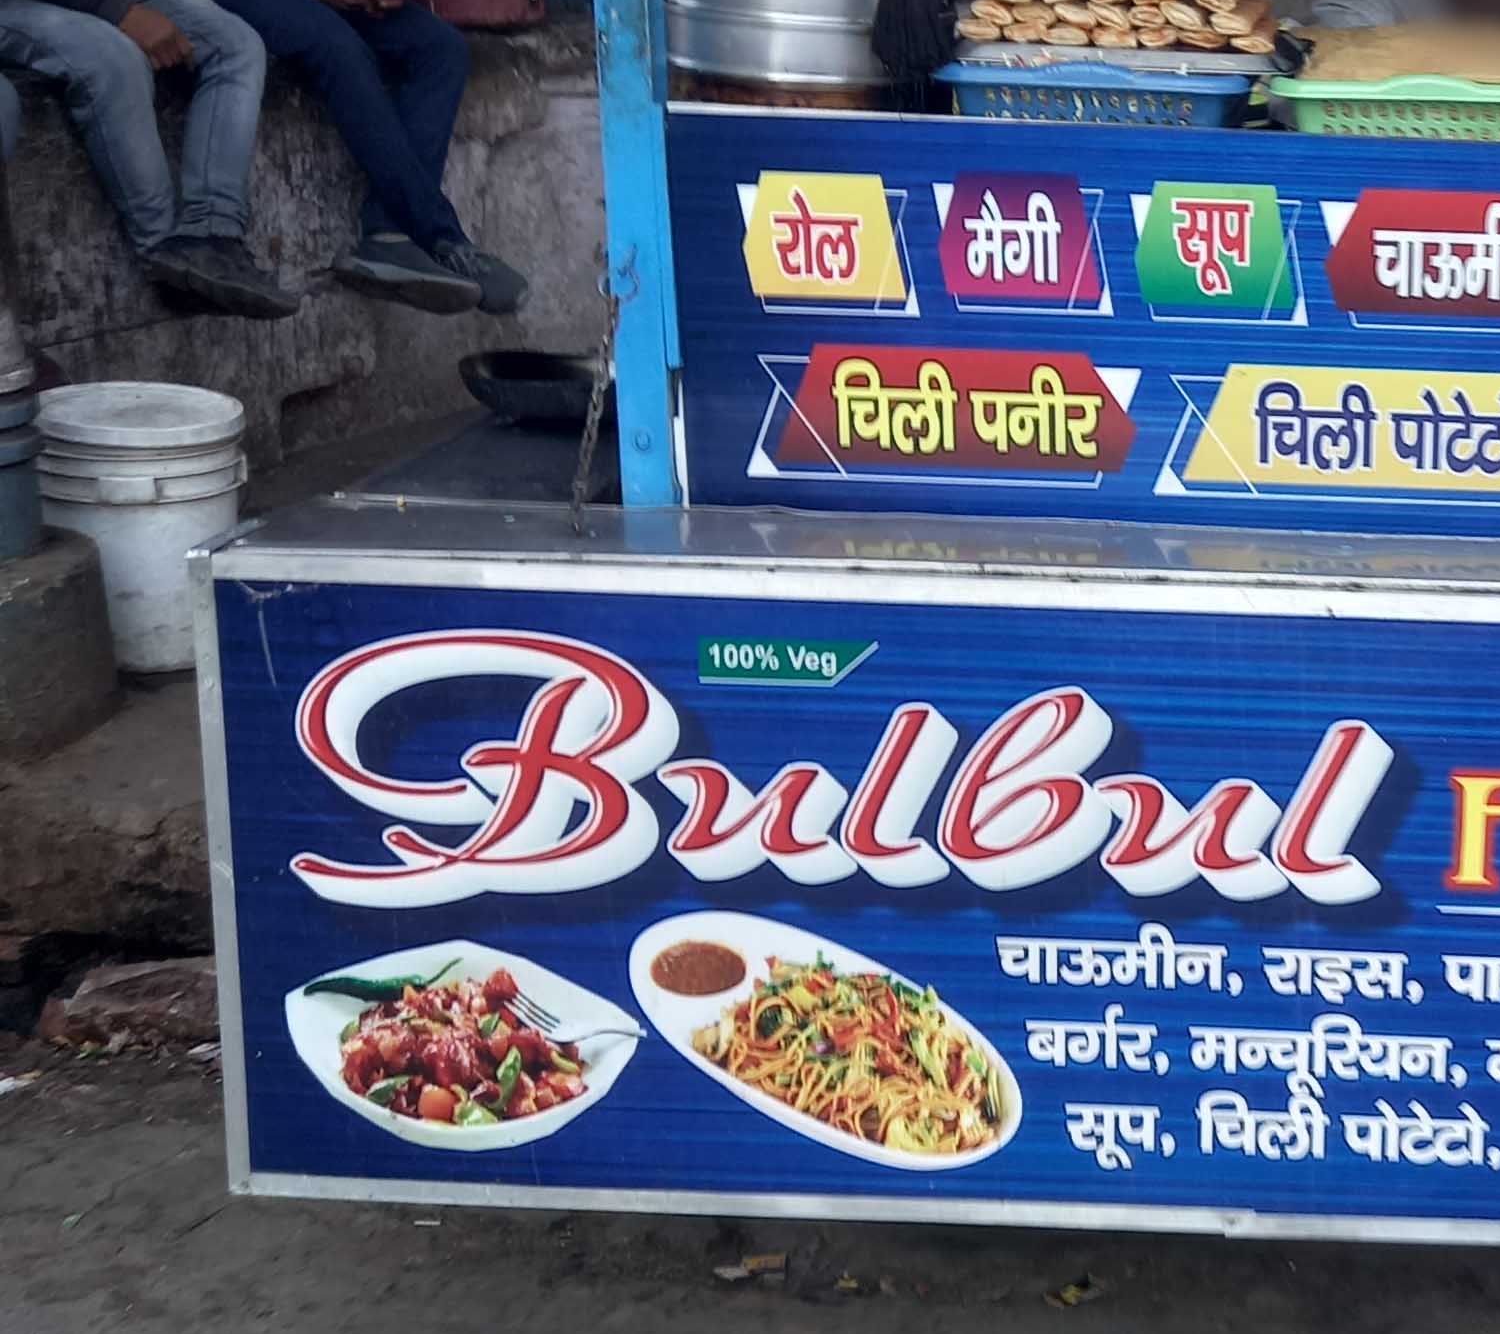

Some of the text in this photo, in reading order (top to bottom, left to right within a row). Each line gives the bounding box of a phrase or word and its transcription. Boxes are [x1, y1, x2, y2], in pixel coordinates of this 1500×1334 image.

[770, 186, 862, 284] रोल
[963, 188, 1062, 285] मैगी
[1170, 197, 1254, 297] सूप
[832, 356, 1103, 460] चिली पनीर
[1254, 381, 1377, 476] चिली
[708, 643, 837, 677] 100% Veg
[289, 628, 1395, 909] Bulbul
[996, 922, 1244, 997] चाऊमीन,
[1261, 944, 1425, 1006] राइस,
[1024, 1003, 1170, 1075] बर्गर,
[1064, 1102, 1176, 1171] सूप,
[1196, 1089, 1330, 1164] चिली
